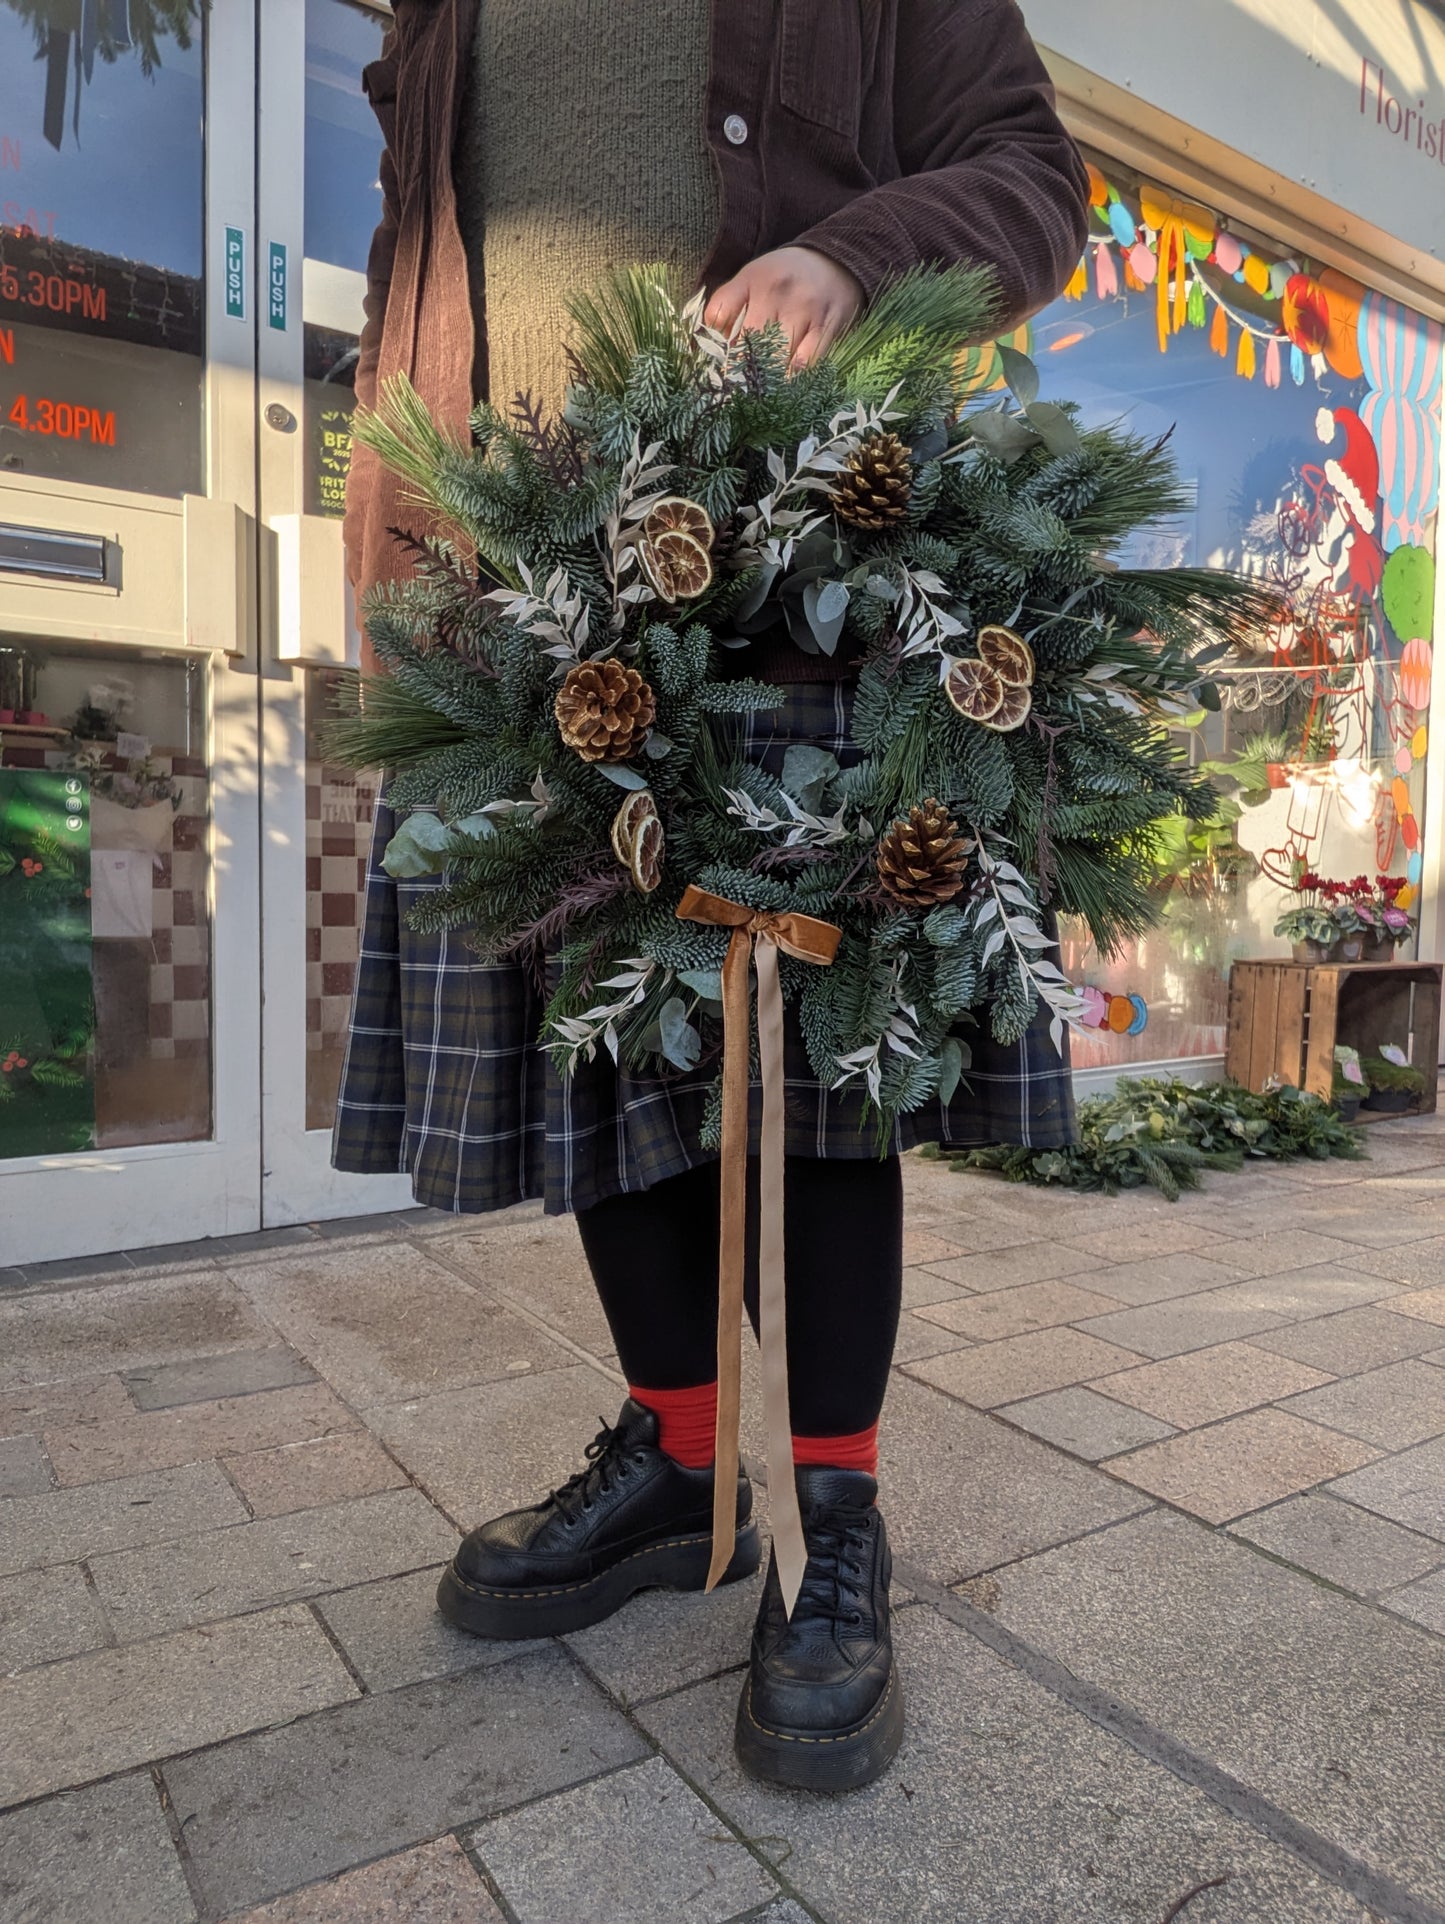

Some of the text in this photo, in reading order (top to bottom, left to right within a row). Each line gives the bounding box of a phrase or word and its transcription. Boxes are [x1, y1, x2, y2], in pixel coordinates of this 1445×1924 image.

[1360, 57, 1445, 167] Florist
[3, 200, 58, 245] SAT
[0, 264, 107, 321] 5.30PM
[228, 241, 241, 305] PUSH
[272, 255, 284, 318] PUSH
[8, 393, 117, 447] 4.30PM
